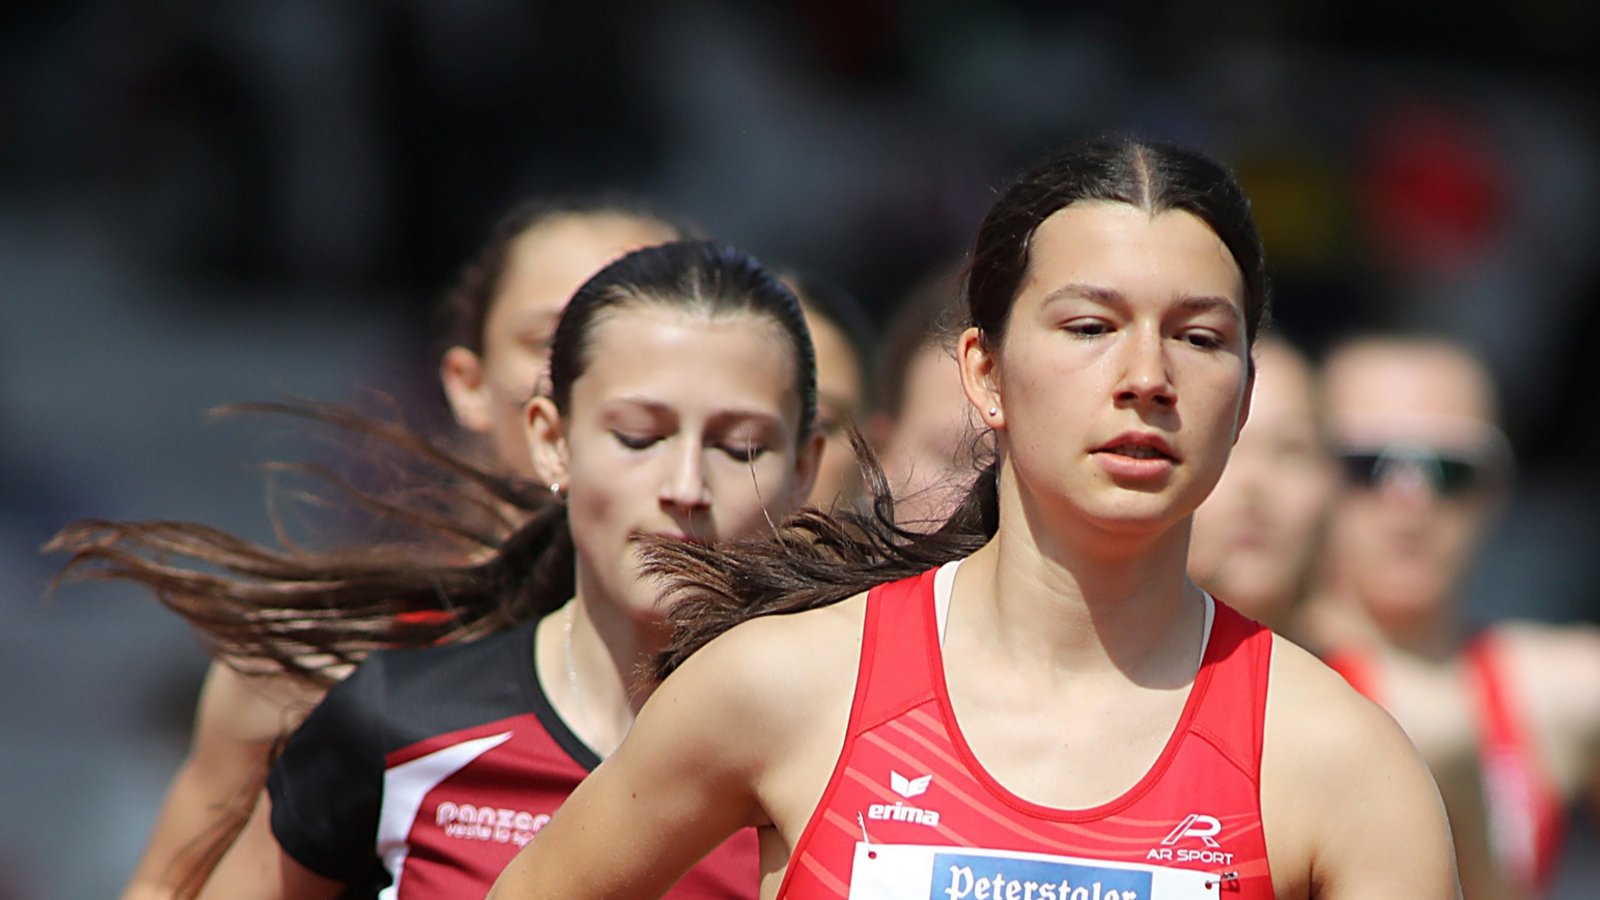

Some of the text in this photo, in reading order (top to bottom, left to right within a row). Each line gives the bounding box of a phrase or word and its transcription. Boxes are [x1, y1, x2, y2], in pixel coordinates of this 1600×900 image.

[868, 801, 939, 827] erima
[1146, 848, 1233, 865] AR SPORT
